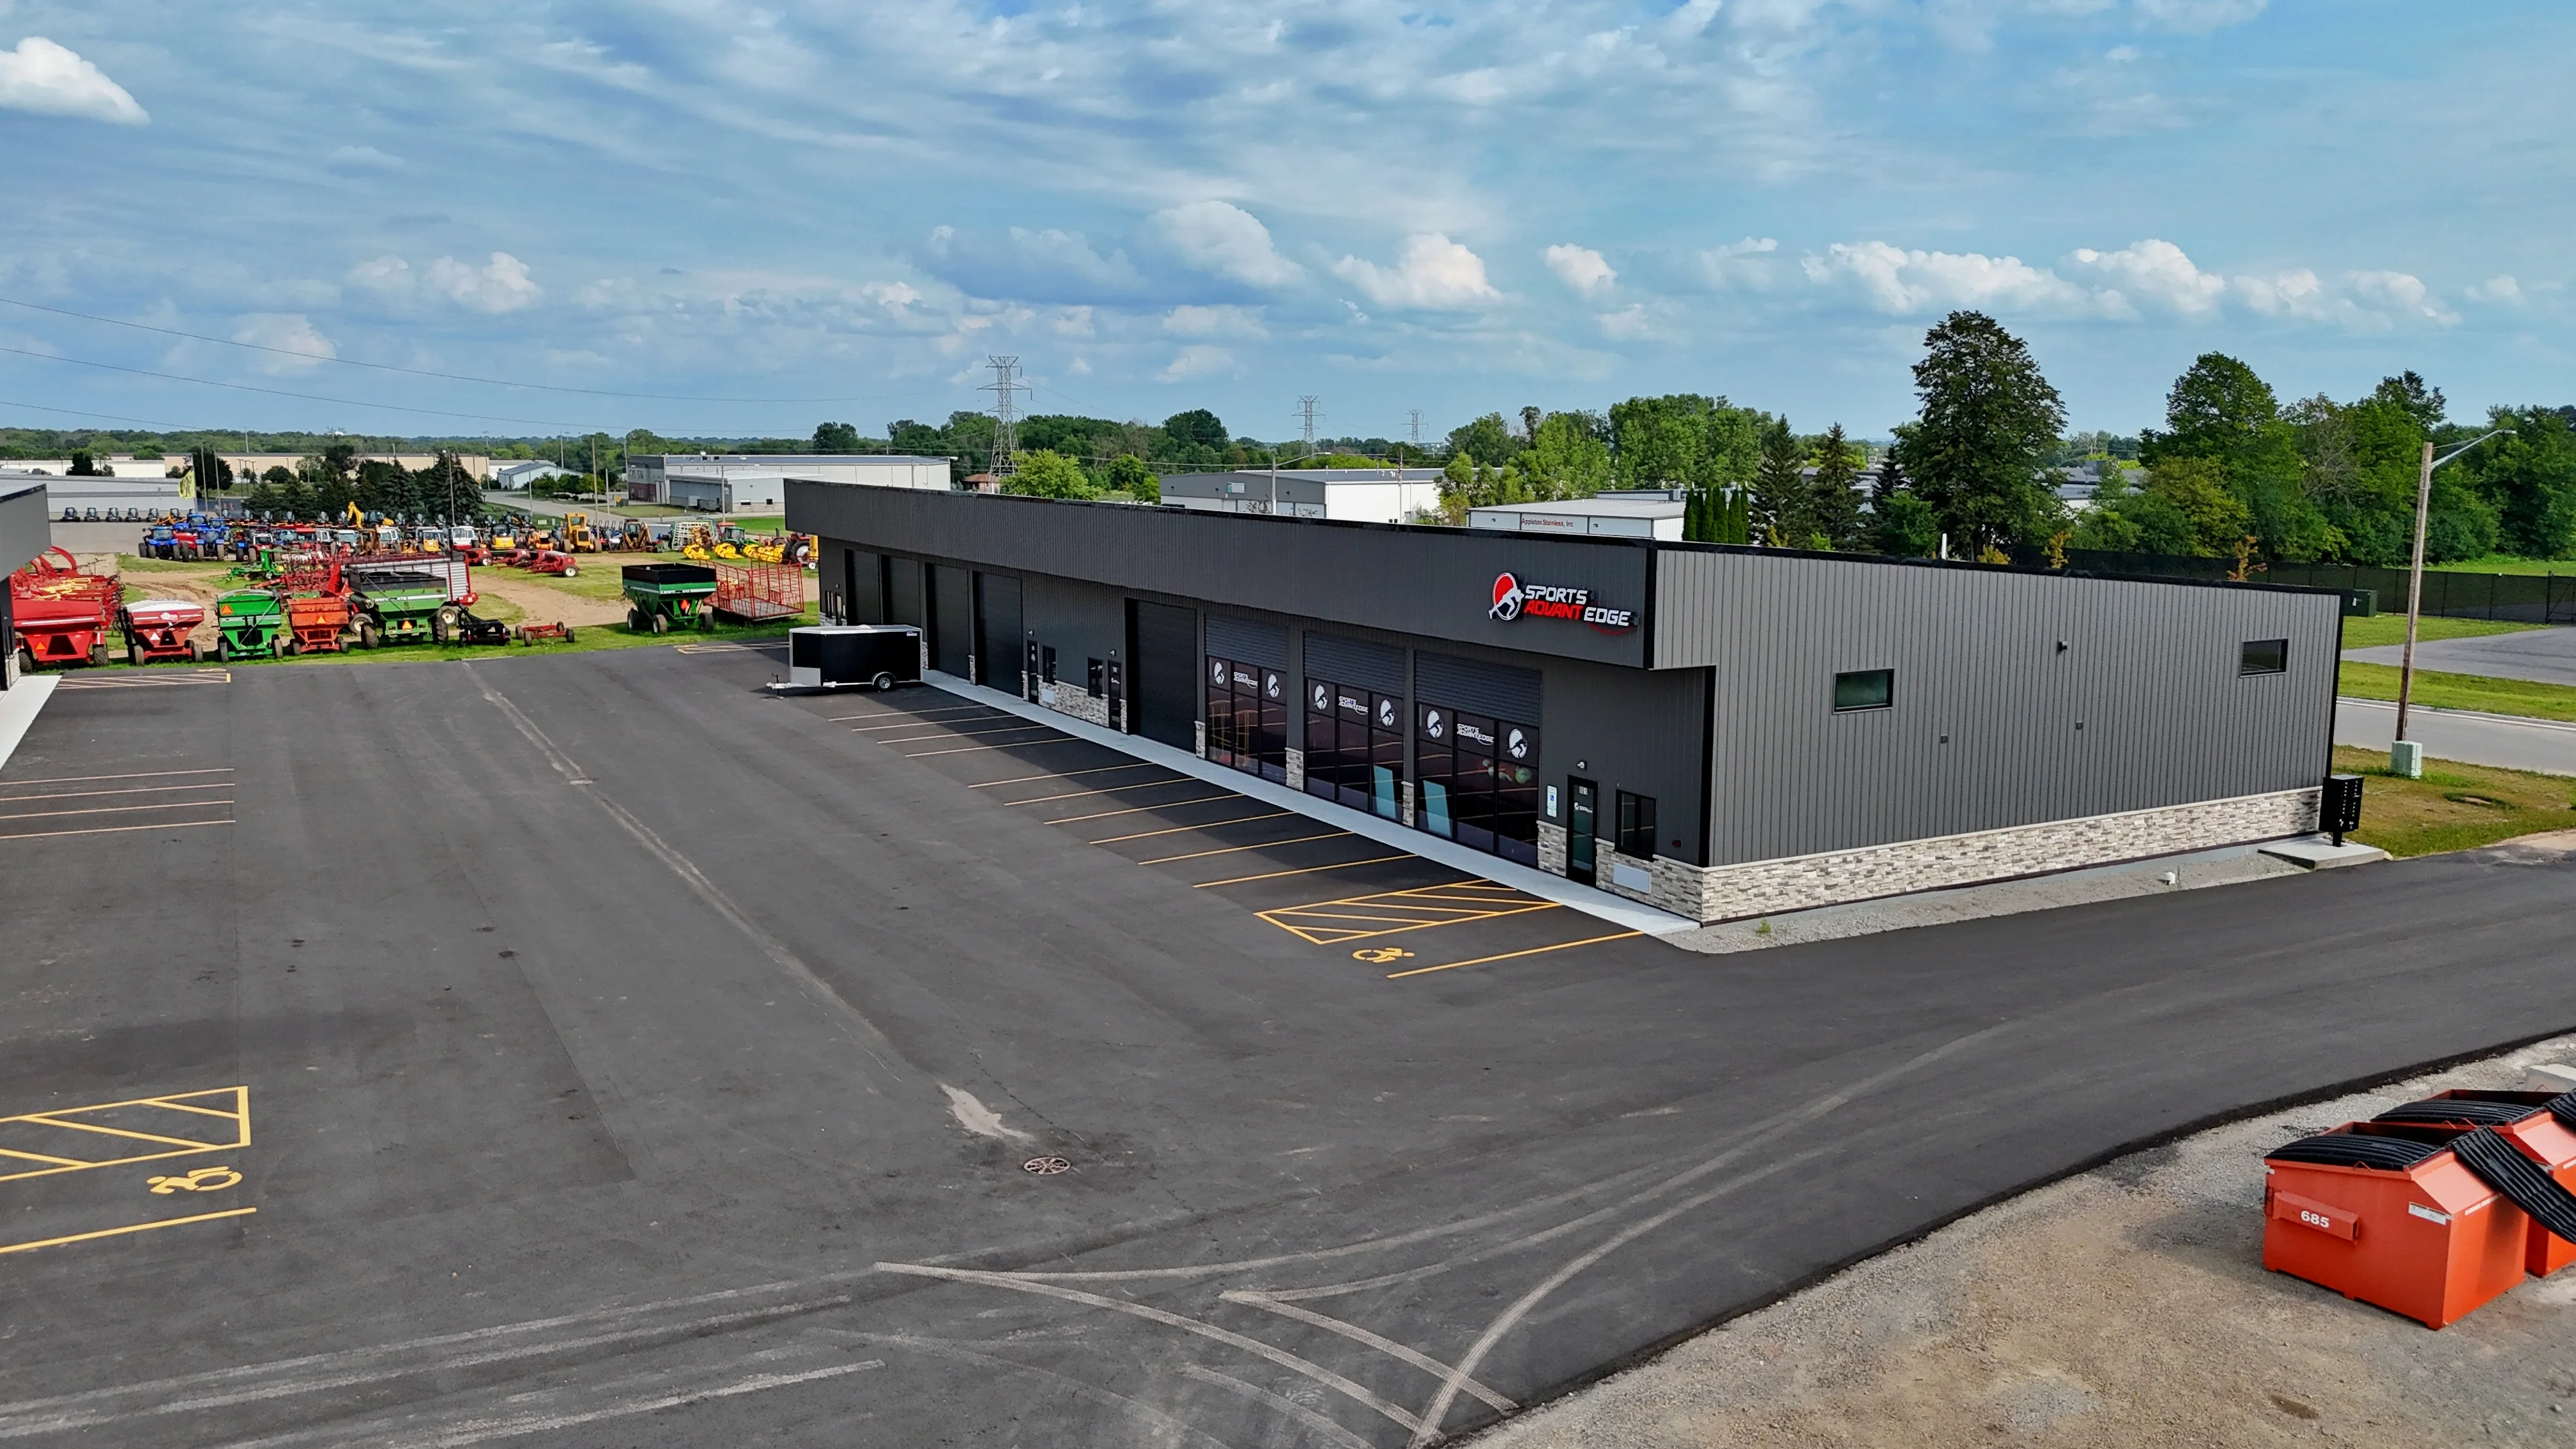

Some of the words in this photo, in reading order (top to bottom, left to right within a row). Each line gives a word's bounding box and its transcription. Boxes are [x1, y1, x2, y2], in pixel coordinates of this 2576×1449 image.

[1524, 585, 1588, 604] SPORTS
[1457, 723, 1480, 733] SPORTS
[2301, 1210, 2330, 1228] 685
